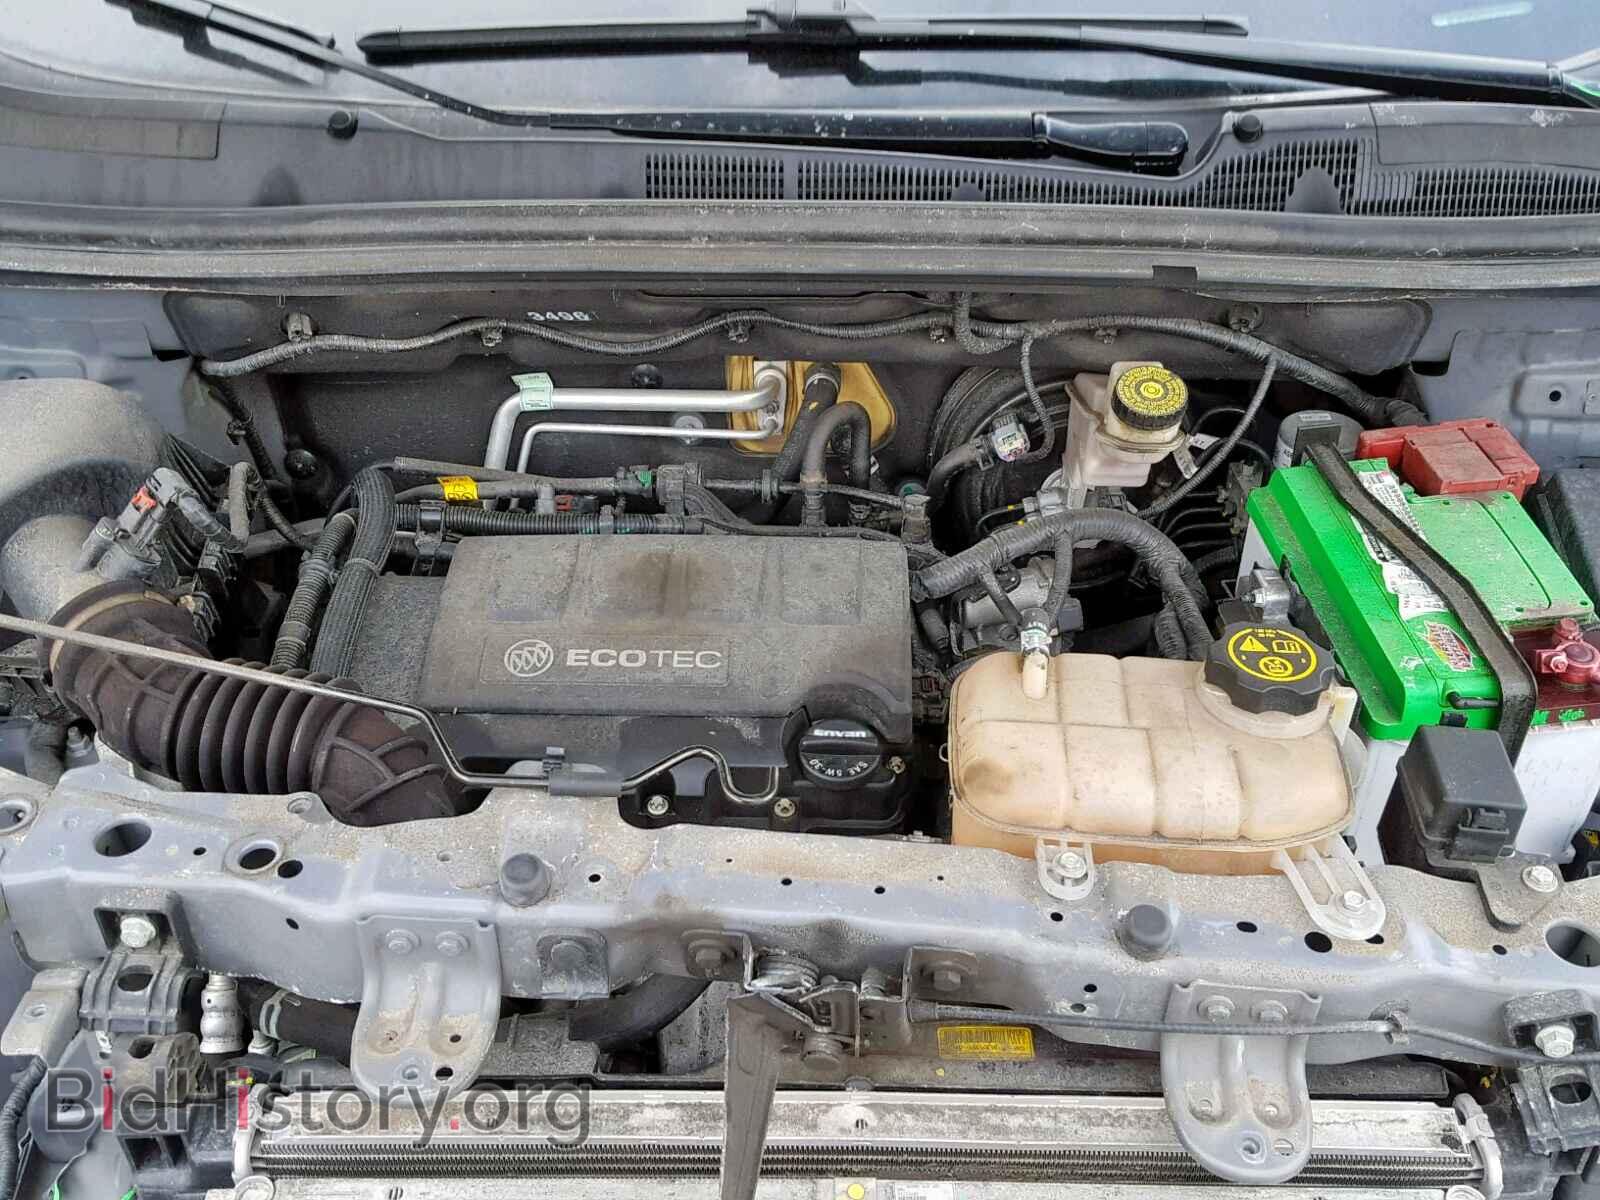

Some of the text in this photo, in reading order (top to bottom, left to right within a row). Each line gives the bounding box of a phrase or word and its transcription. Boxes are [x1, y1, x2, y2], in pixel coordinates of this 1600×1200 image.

[566, 649, 722, 668] ECOTEC
[809, 759, 869, 777] SAE 5W-30
